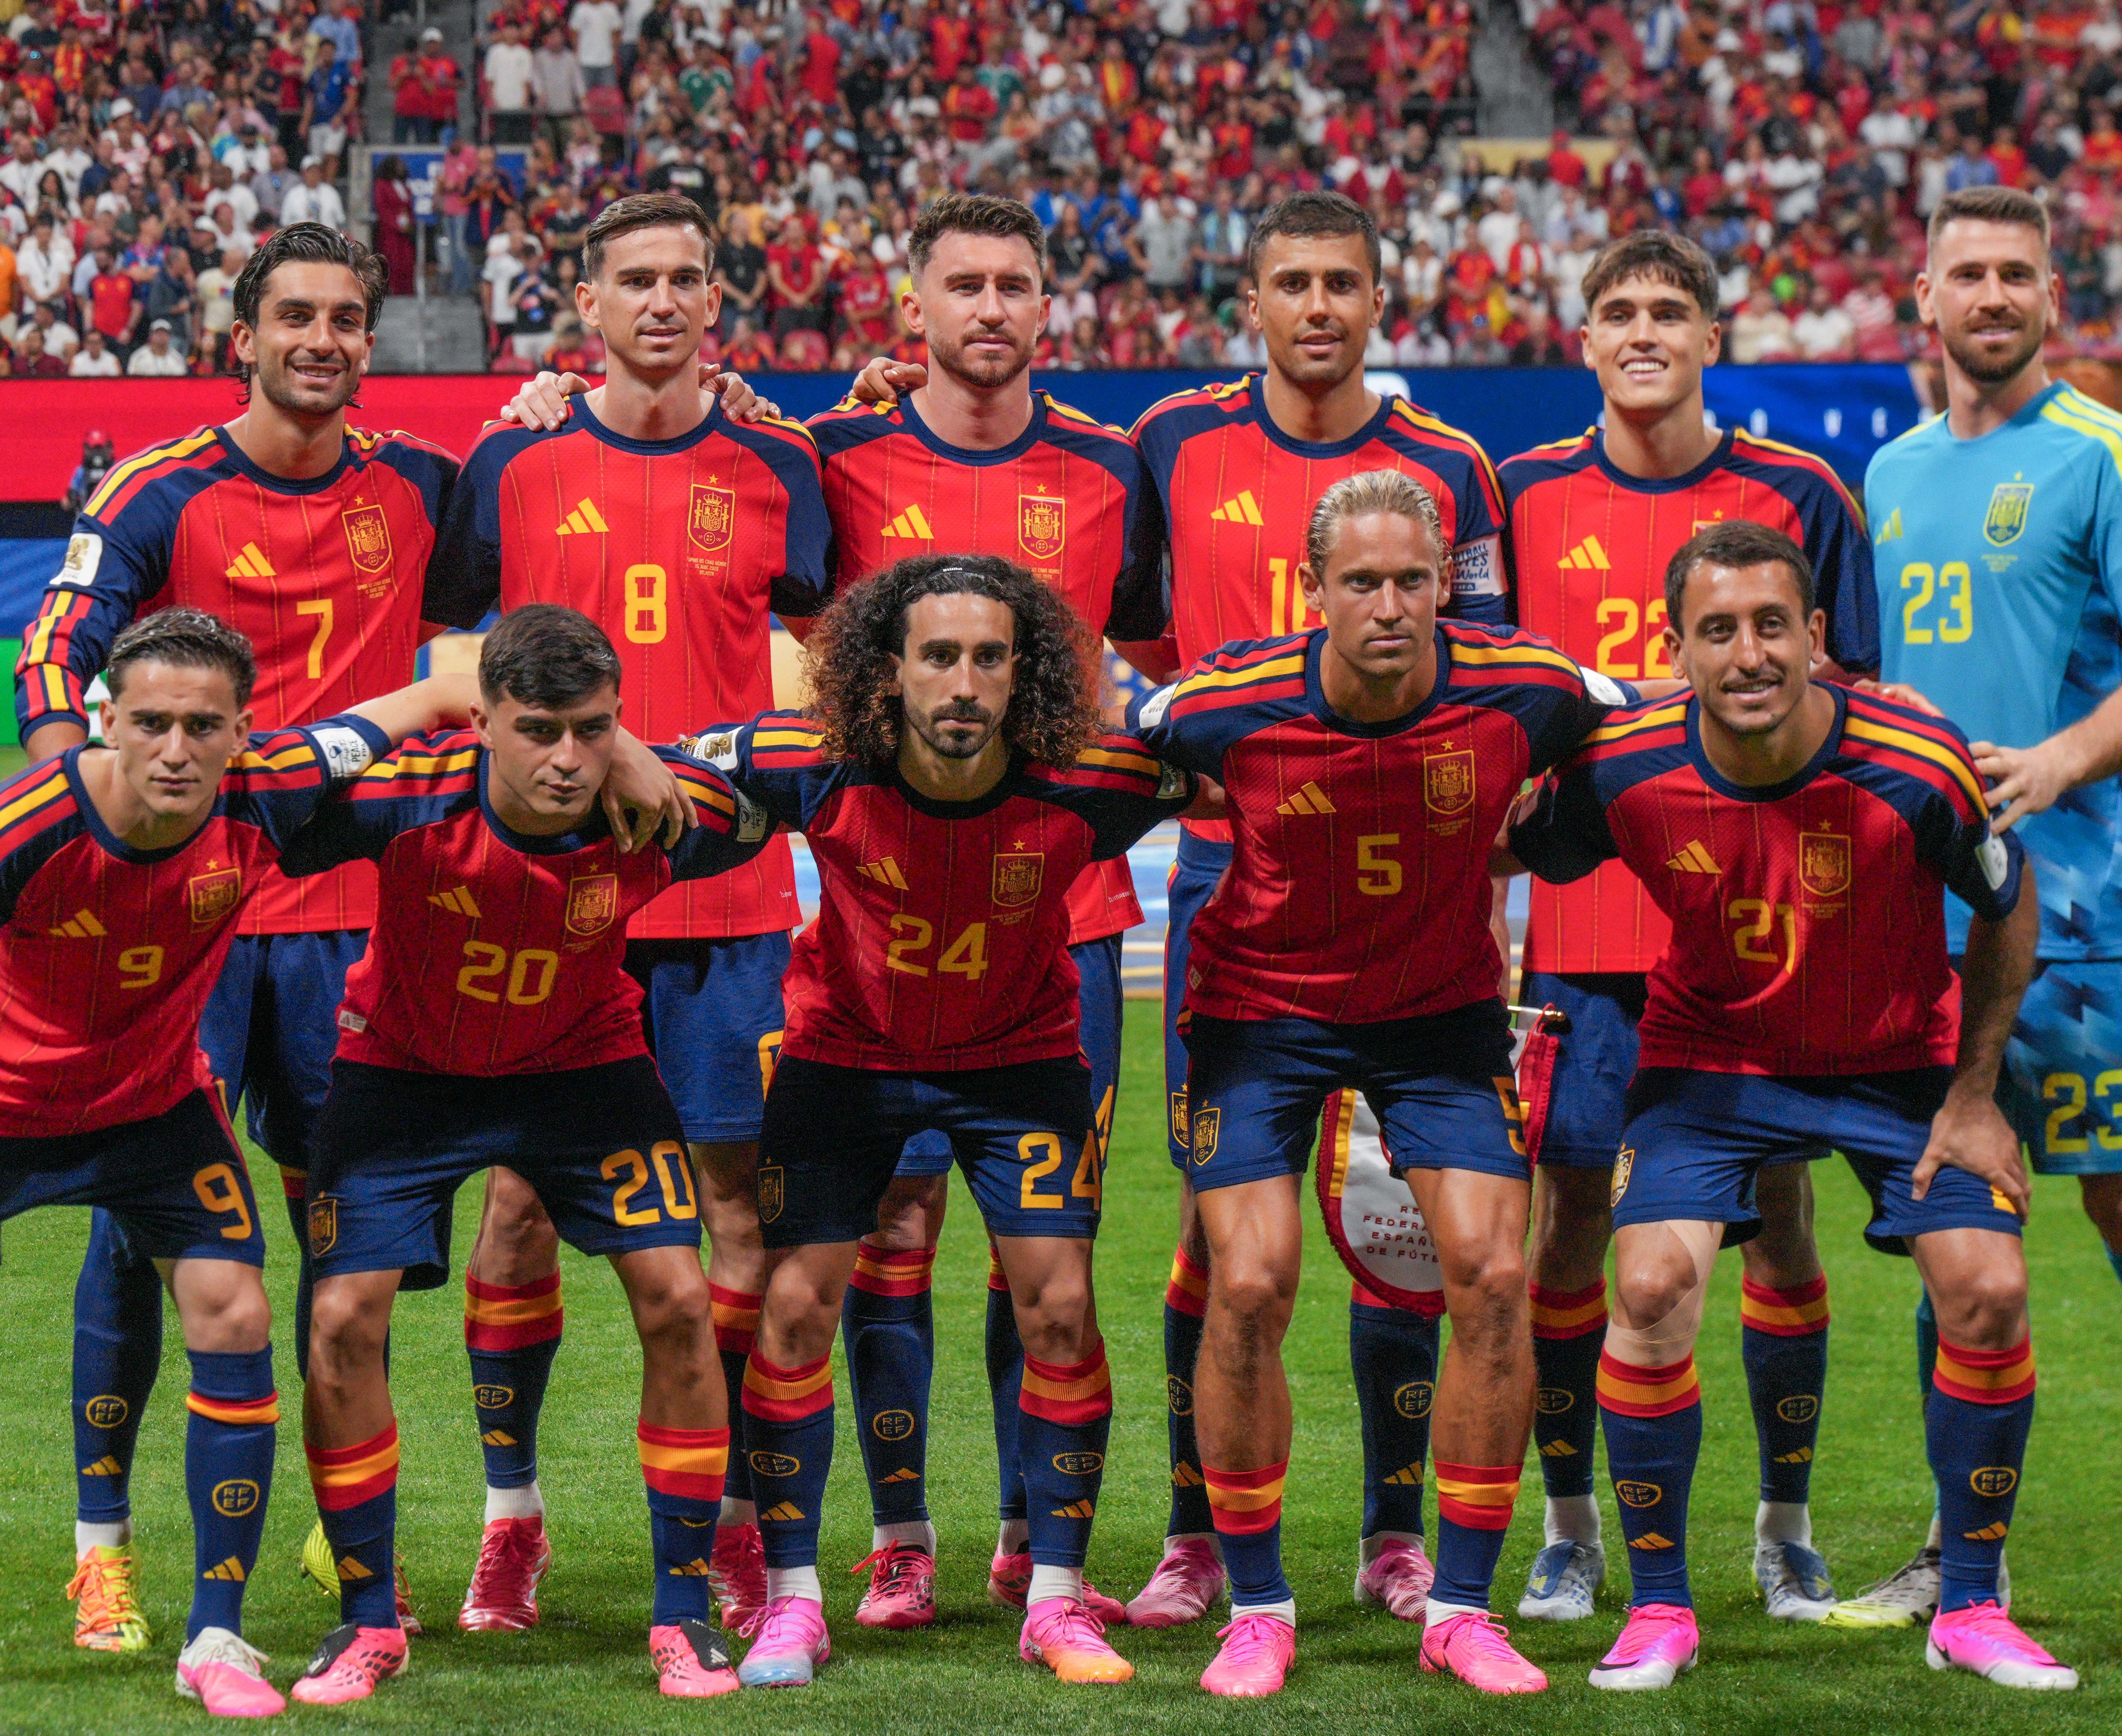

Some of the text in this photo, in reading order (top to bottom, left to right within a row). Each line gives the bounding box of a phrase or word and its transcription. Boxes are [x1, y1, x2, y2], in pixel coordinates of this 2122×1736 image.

[625, 564, 667, 644] 8
[1900, 561, 1973, 644] 23
[297, 599, 333, 679] 7
[1597, 598, 1673, 679] 22
[1357, 833, 1403, 895] 5
[886, 913, 989, 980] 24
[1729, 898, 1796, 975] 21
[118, 945, 164, 989] 9
[456, 940, 558, 1005] 20
[2043, 1069, 2122, 1154] 23
[600, 1141, 697, 1227] 20
[1018, 1129, 1102, 1211] 24
[193, 1163, 252, 1240] 9
[1400, 1206, 1419, 1215] RE
[1367, 1246, 1387, 1255] DE
[1372, 1232, 1431, 1246] ESPAÑ
[1405, 1400, 1427, 1410] EF
[1406, 1389, 1427, 1399] RF
[882, 1416, 904, 1425] RF
[882, 1426, 903, 1434] EF
[224, 1487, 250, 1497] RF
[1624, 1485, 1651, 1494] RF
[1981, 1473, 2008, 1482] RF
[1981, 1481, 2006, 1490] EF
[223, 1498, 249, 1508] EF
[1625, 1493, 1649, 1502] EF
